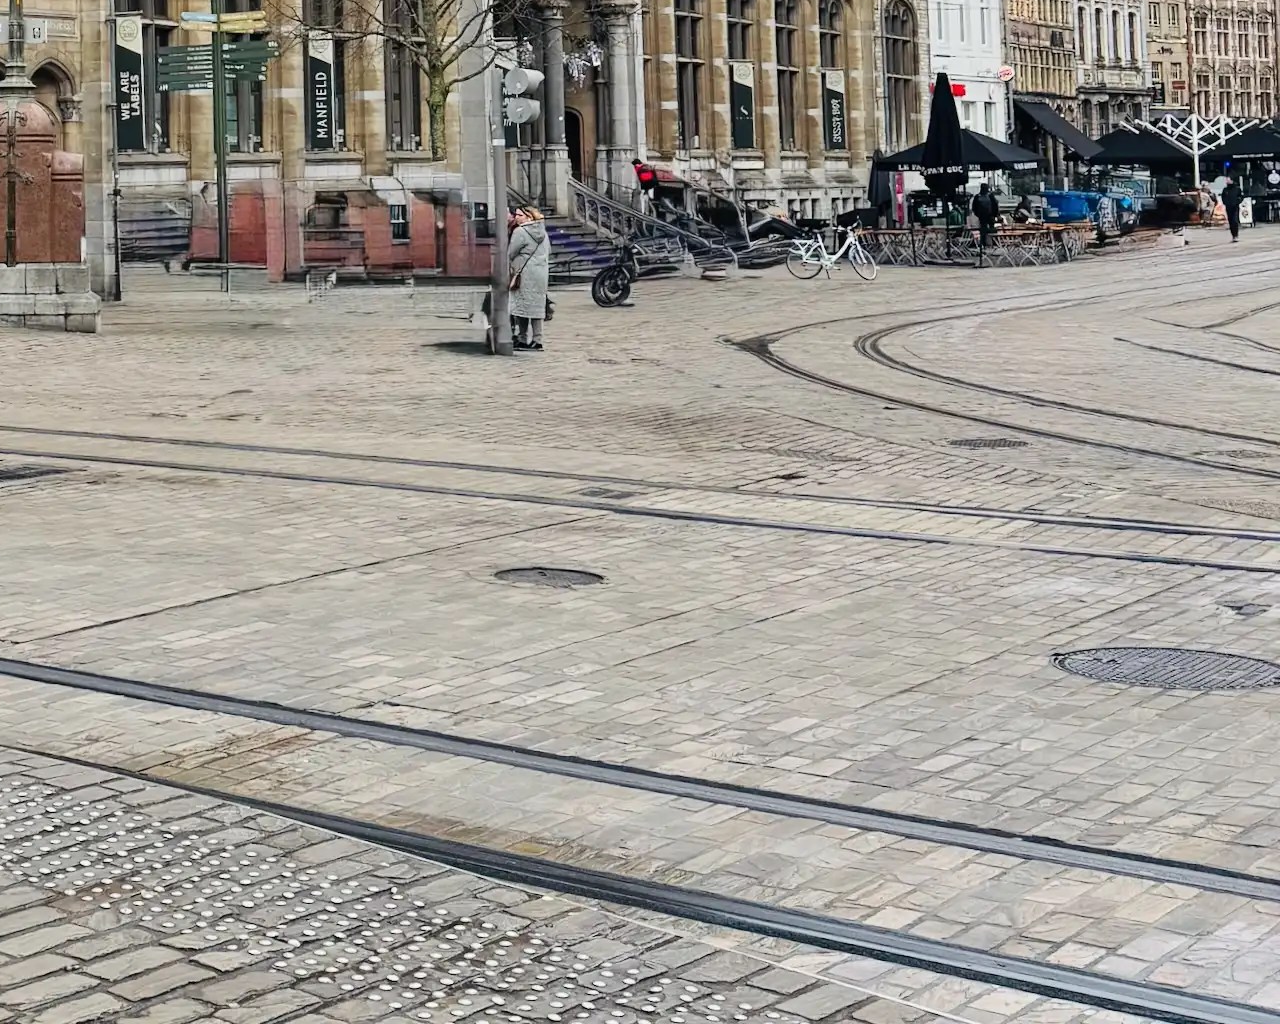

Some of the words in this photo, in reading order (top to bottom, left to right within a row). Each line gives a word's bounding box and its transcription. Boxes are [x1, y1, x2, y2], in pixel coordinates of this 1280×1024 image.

[120, 71, 130, 94] ARE
[130, 74, 141, 116] LABELS
[121, 102, 131, 121] WE
[315, 72, 329, 138] MANFIELD
